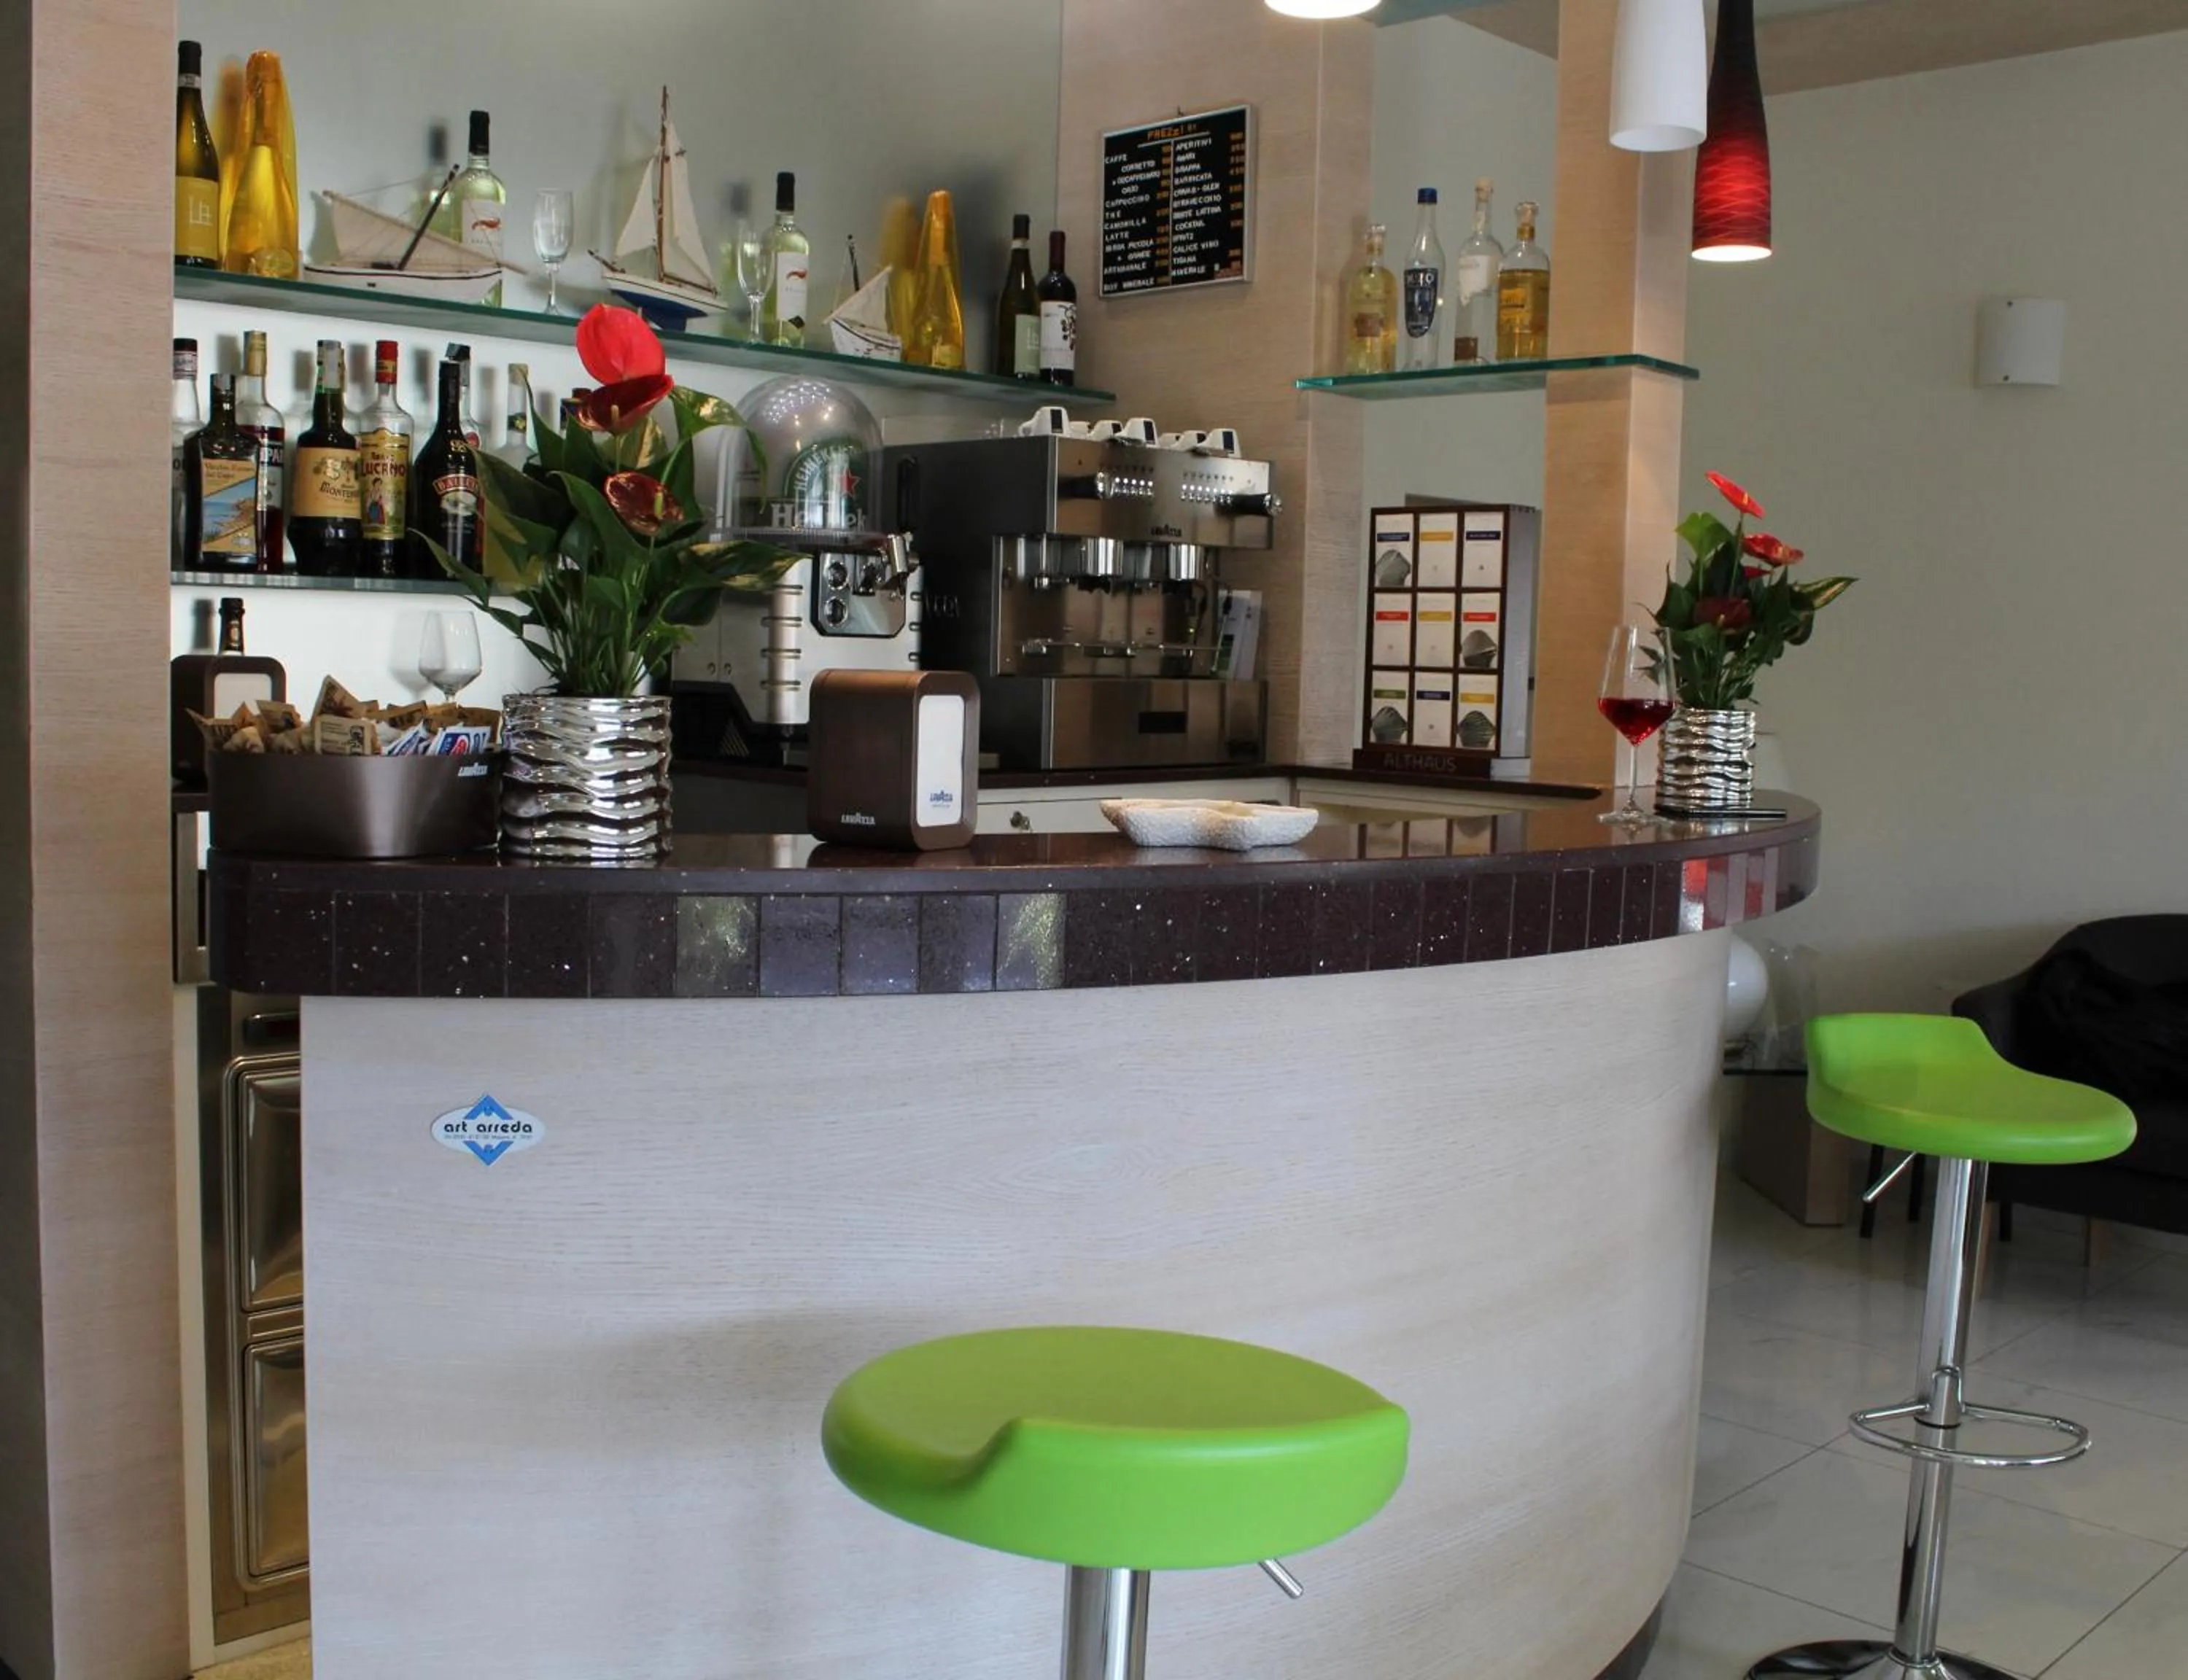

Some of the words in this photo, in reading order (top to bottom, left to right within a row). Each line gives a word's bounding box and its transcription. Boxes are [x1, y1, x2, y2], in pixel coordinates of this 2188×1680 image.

[1105, 231, 1130, 242] LATTE
[1384, 752, 1457, 772] ALTHAUS
[444, 1121, 467, 1132] art
[476, 1121, 532, 1133] arreda
